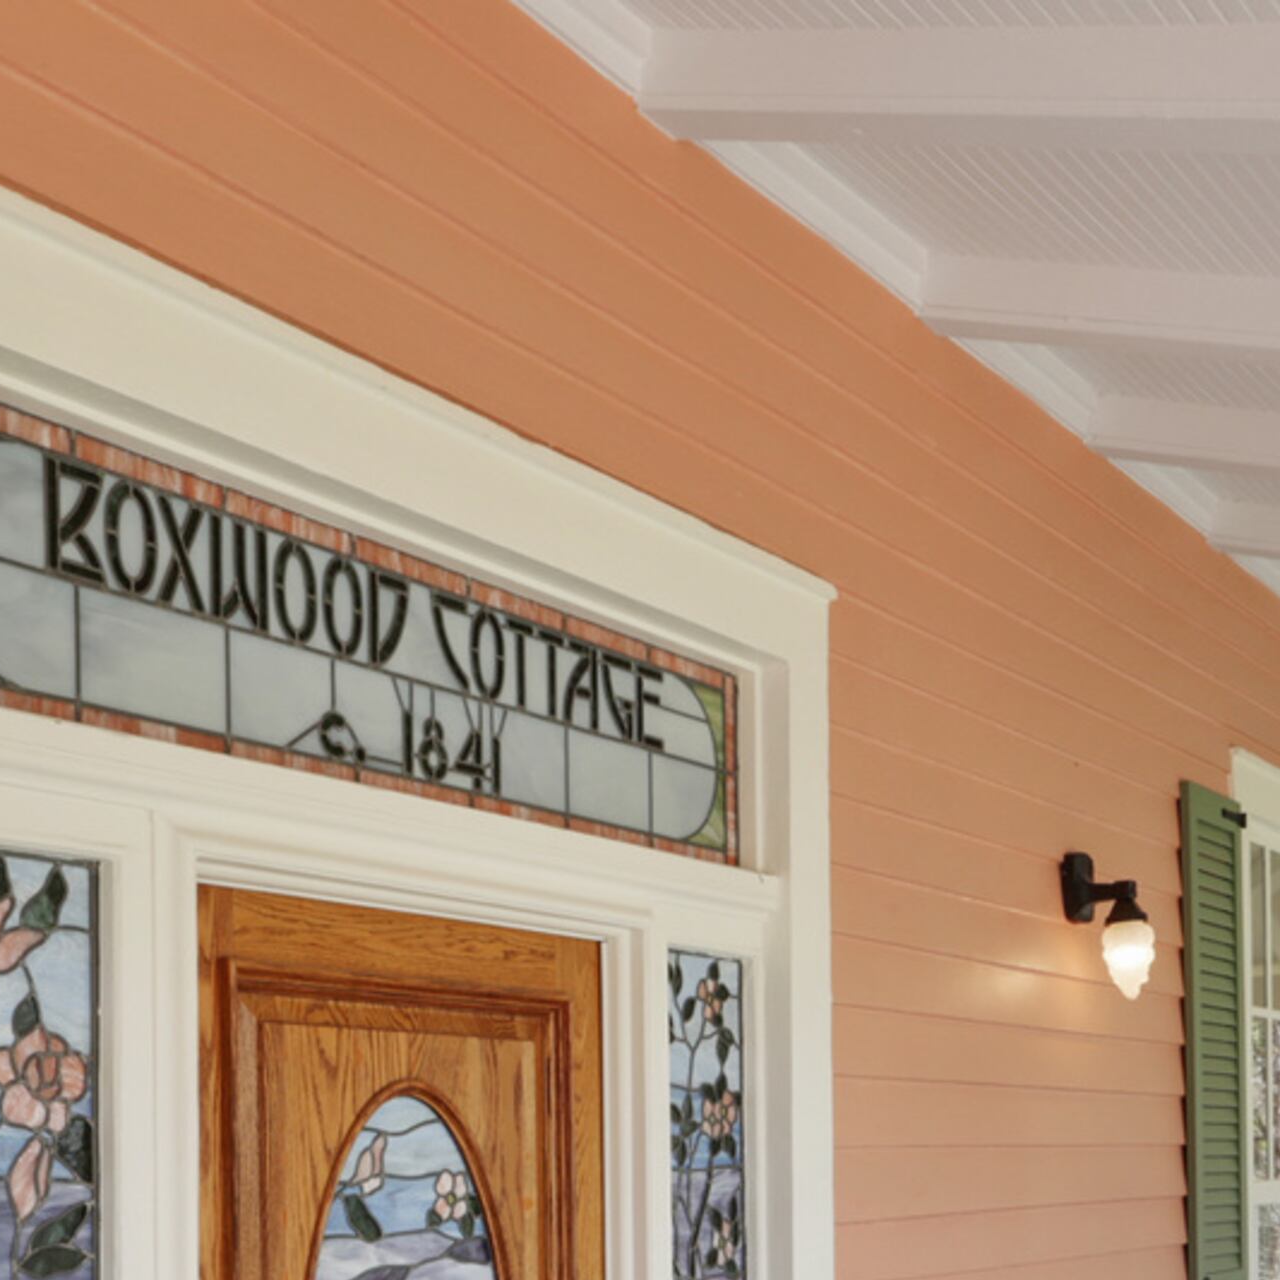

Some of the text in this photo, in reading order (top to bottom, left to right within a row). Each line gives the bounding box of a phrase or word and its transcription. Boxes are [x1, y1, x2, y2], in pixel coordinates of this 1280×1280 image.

[46, 457, 664, 752] BOXWOOD COTTAGE
[402, 708, 501, 796] 1841
